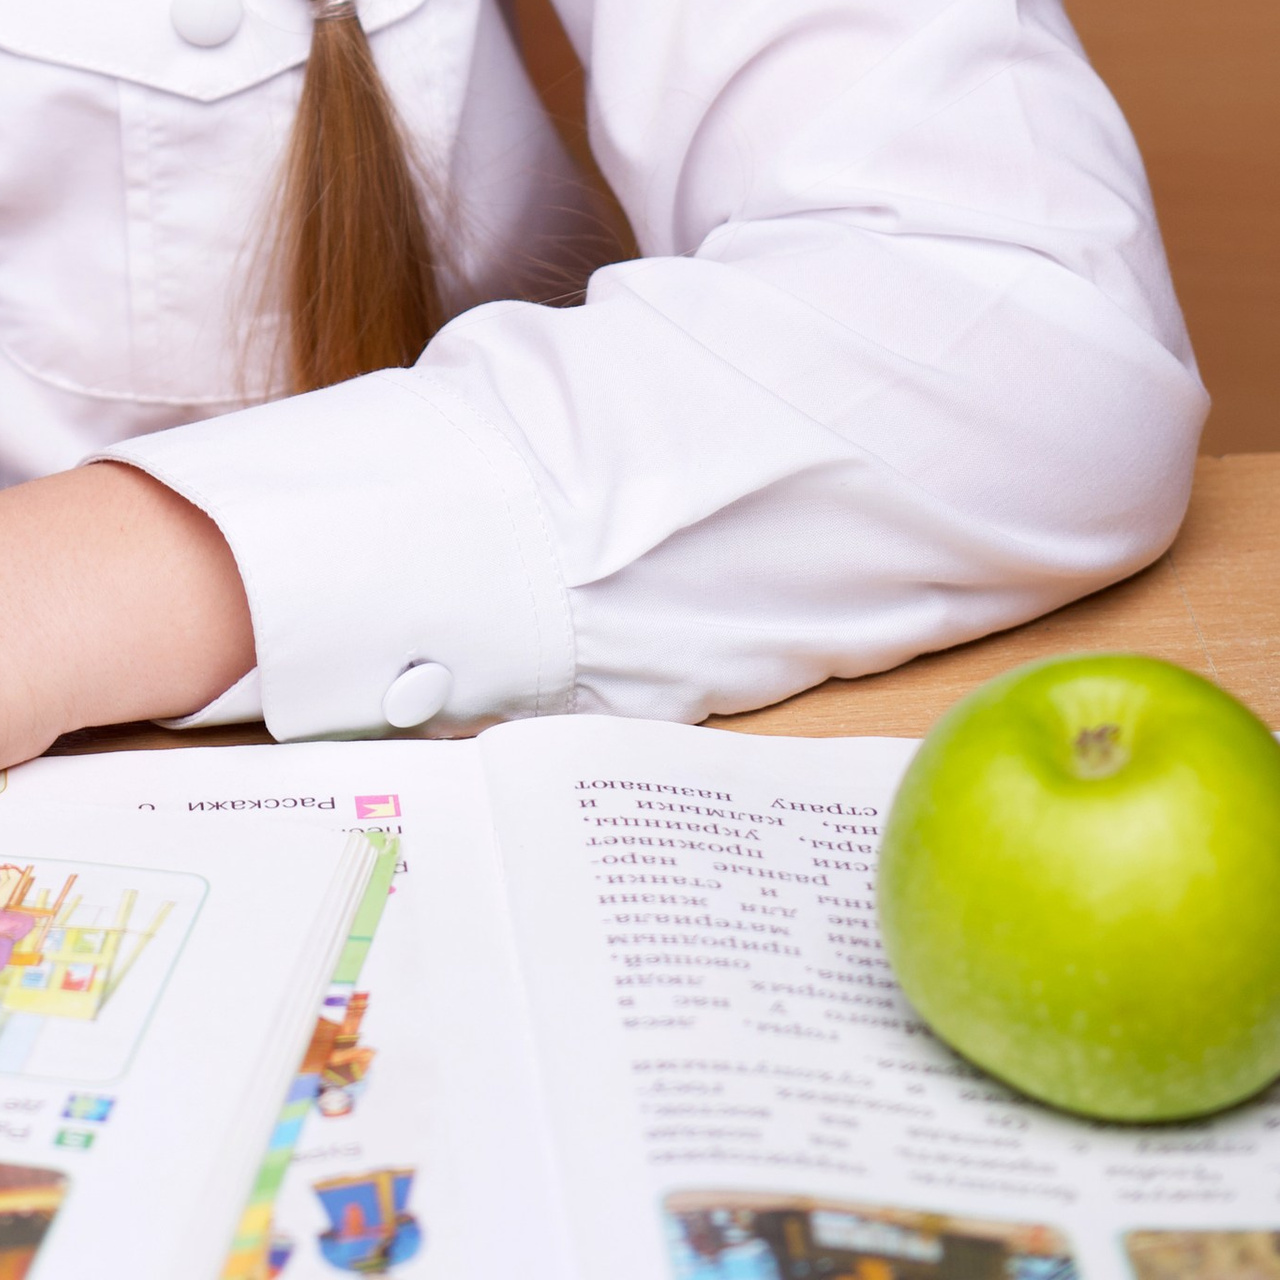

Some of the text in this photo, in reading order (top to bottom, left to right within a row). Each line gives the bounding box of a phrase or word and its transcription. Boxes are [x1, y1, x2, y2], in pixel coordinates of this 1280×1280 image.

[187, 797, 337, 813] Расскажи
[574, 779, 878, 817] страну называют
[578, 799, 598, 811] и
[635, 798, 785, 827] калмыки
[581, 815, 760, 841] украинцы,
[584, 836, 764, 860] проживает
[588, 851, 830, 887] разные наро-
[593, 874, 723, 891] станки.
[597, 893, 709, 907] жизни
[759, 887, 778, 898] и
[739, 902, 798, 919] для
